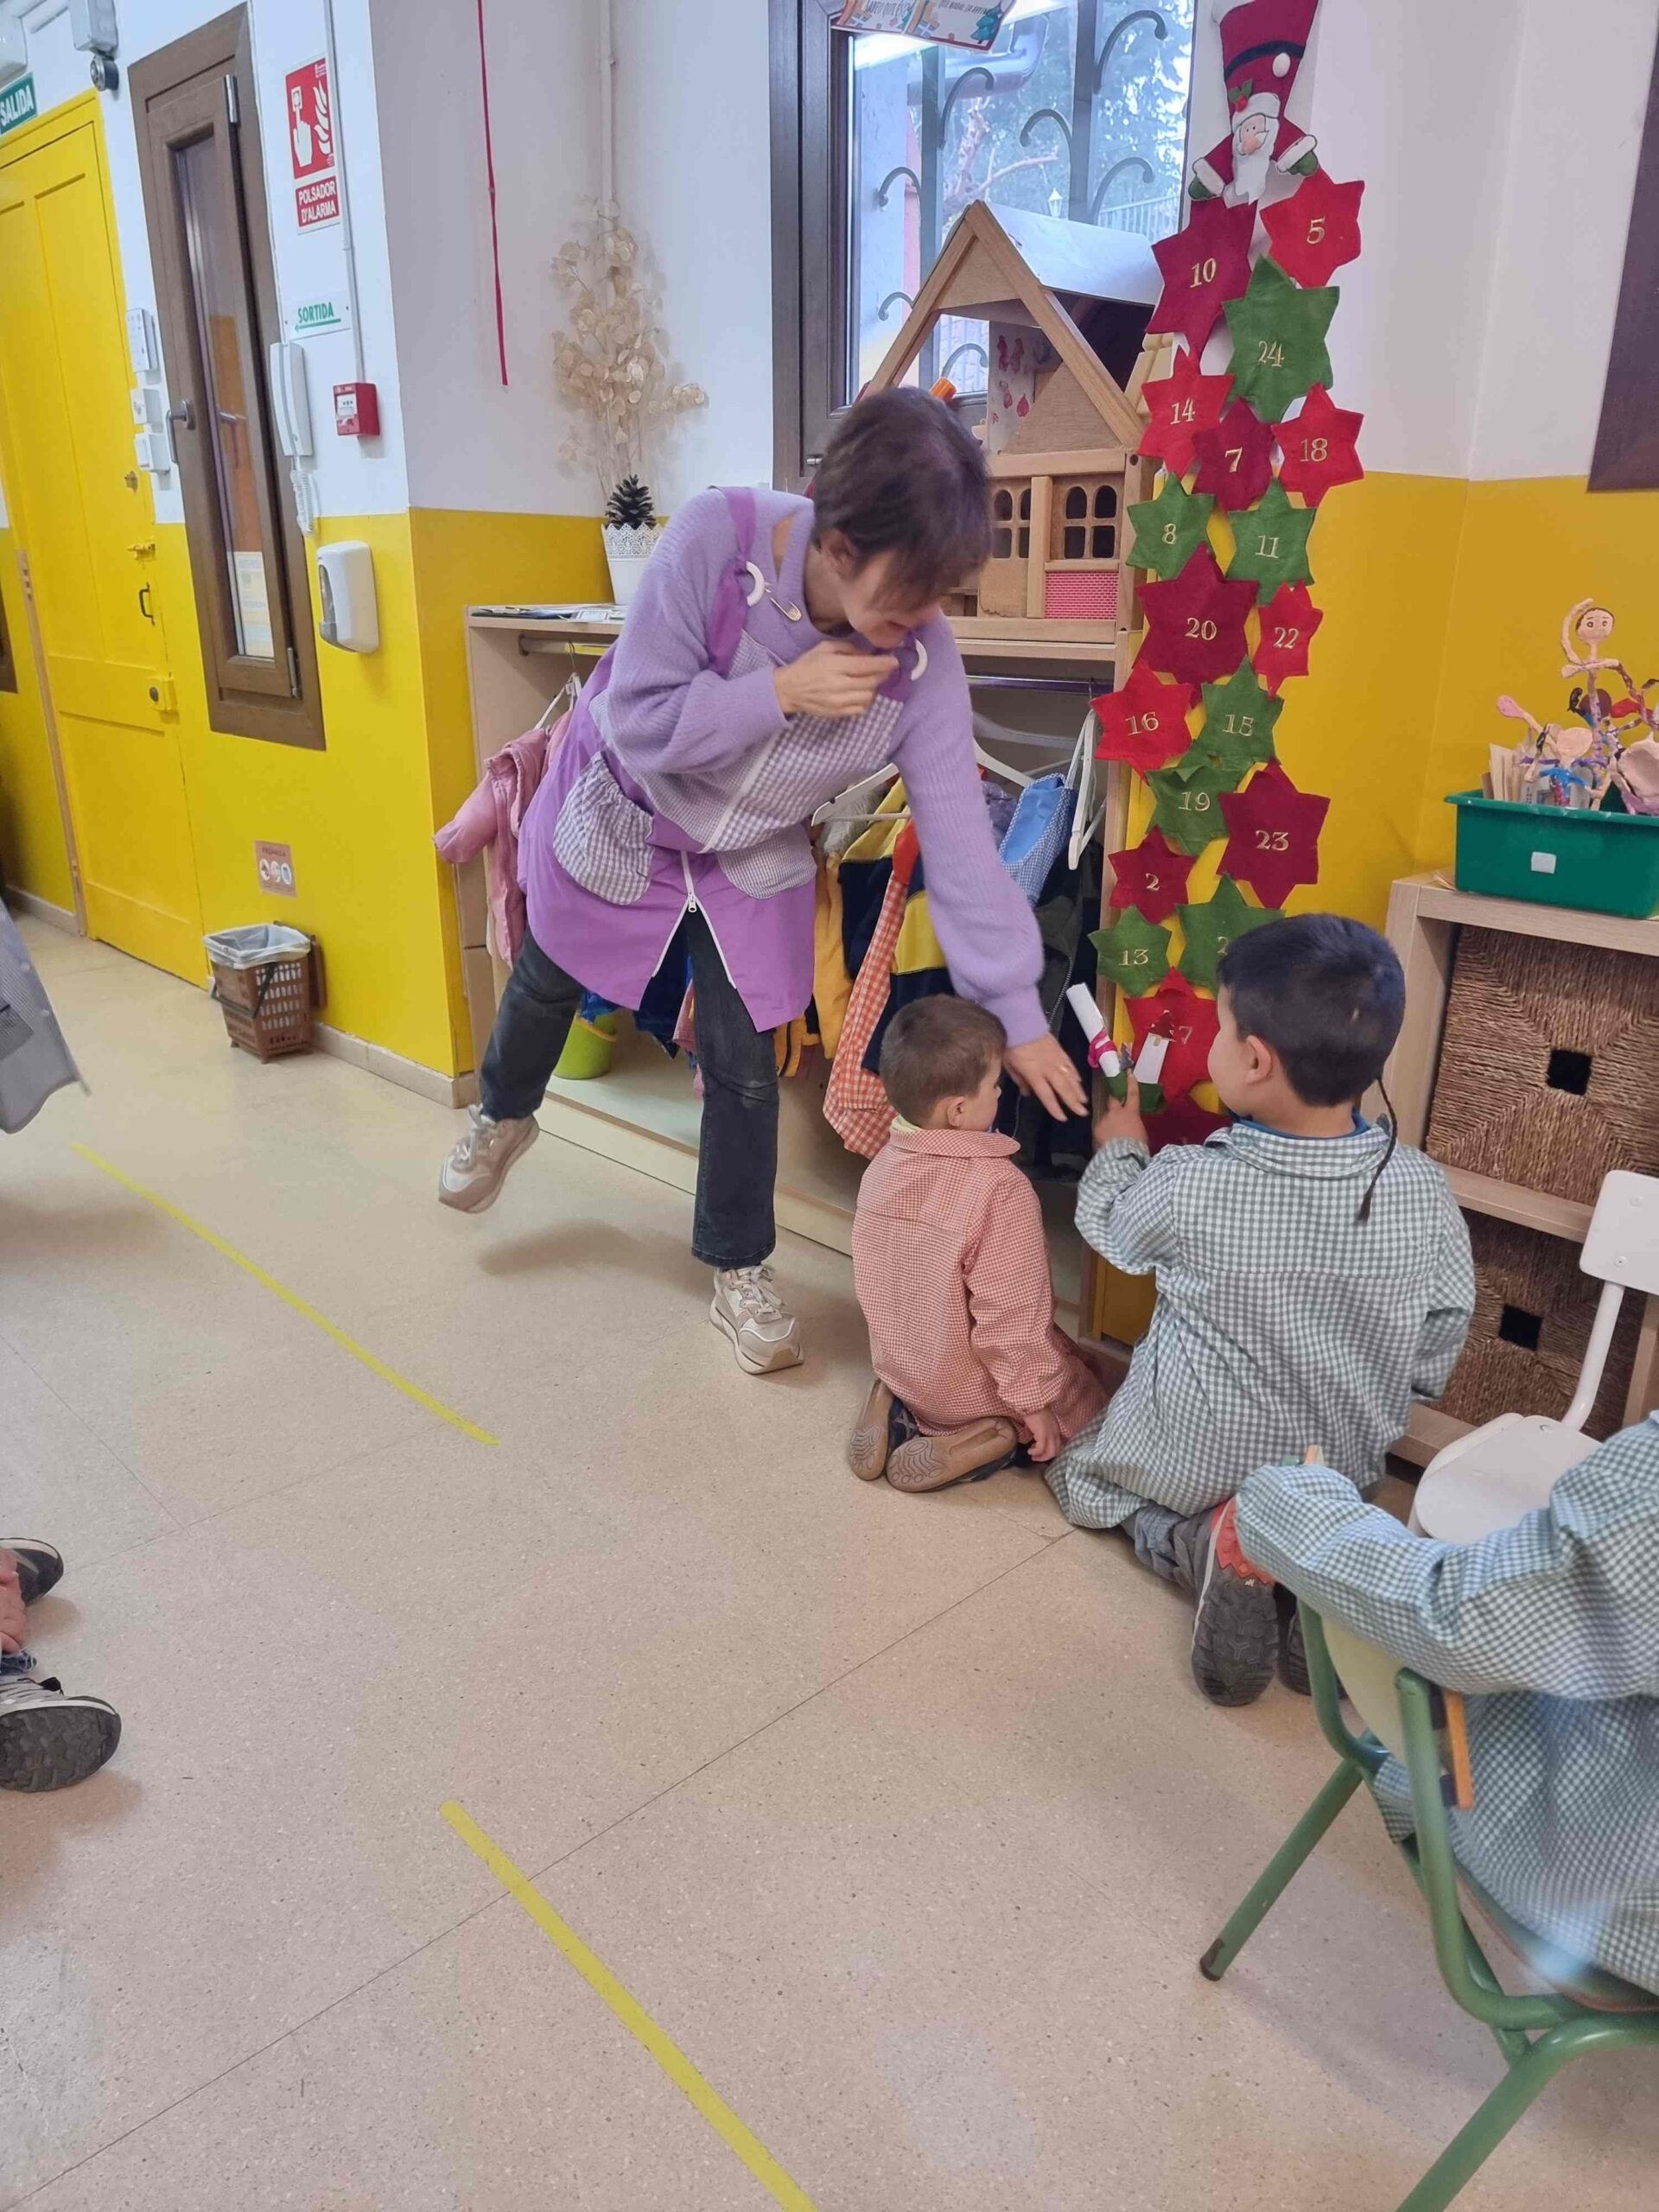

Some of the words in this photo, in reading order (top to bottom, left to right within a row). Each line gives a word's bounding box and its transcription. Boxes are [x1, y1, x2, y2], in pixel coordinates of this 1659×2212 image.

[0, 85, 34, 126] SALIDA
[298, 181, 336, 205] POLSADOR
[302, 200, 336, 223] D'ALARMA
[1306, 217, 1325, 245] 5
[1190, 257, 1217, 288] 10
[298, 302, 334, 323] SORTIDA
[1258, 340, 1284, 367] 24
[1169, 397, 1196, 425] 14
[1224, 448, 1243, 474] 7
[1300, 438, 1328, 462] 18
[1161, 523, 1177, 545] 8
[1255, 535, 1280, 558] 11
[1185, 618, 1217, 641] 20
[1273, 626, 1300, 649] 22
[1125, 712, 1160, 735] 16
[1223, 714, 1254, 736] 15
[1179, 791, 1210, 811] 19
[1255, 830, 1289, 851] 23
[1145, 873, 1160, 892] 2
[1119, 949, 1149, 966] 13
[1217, 936, 1229, 956] 2
